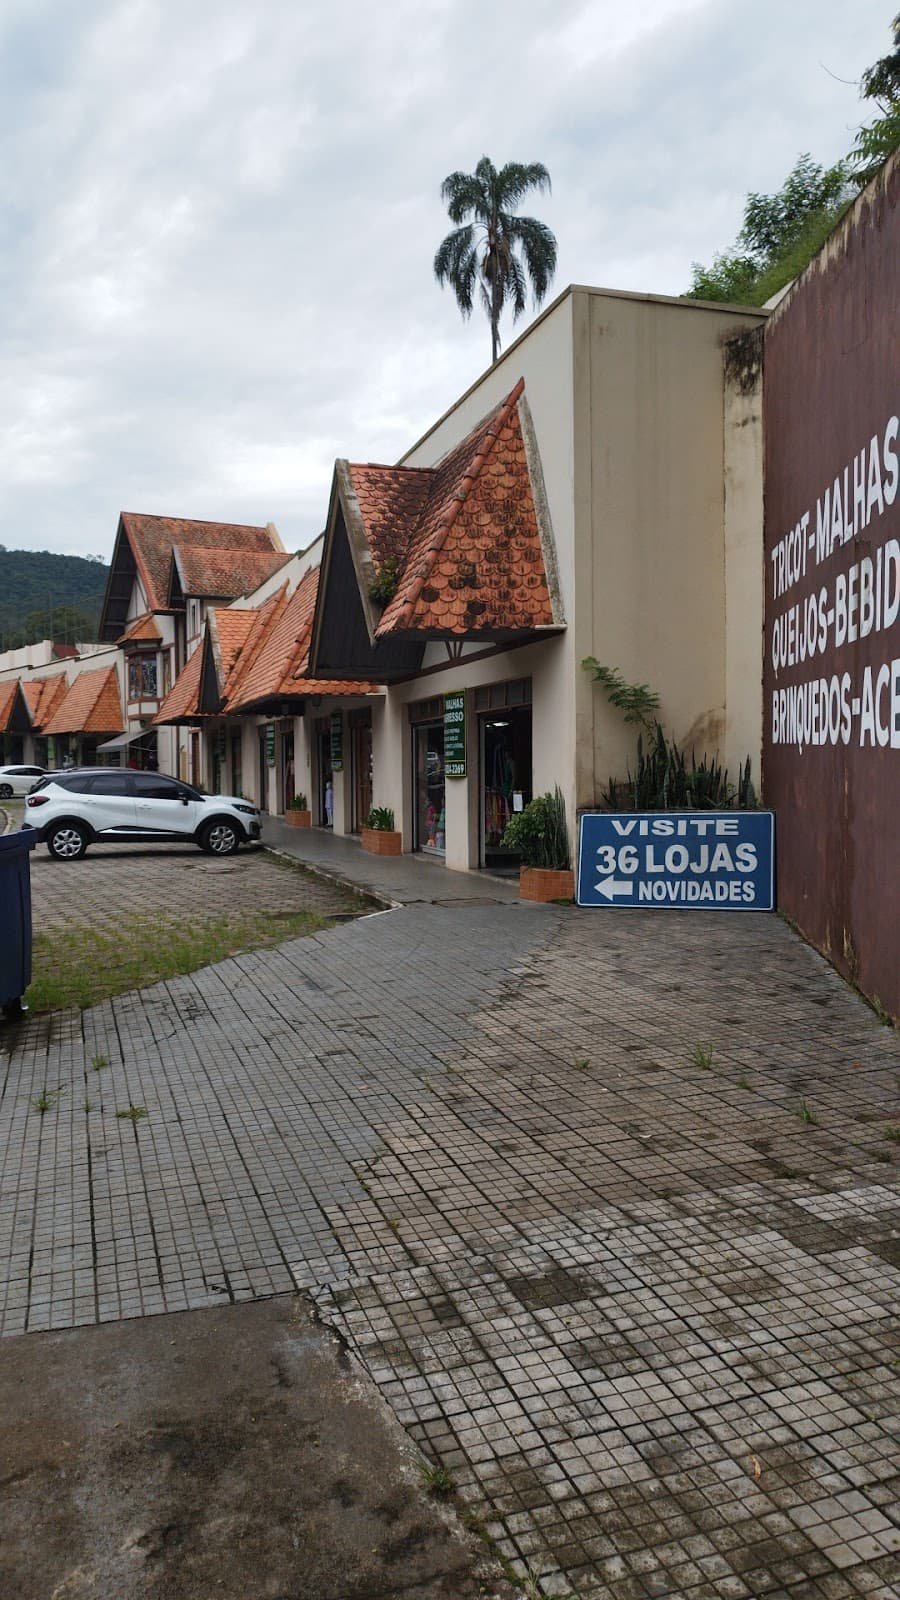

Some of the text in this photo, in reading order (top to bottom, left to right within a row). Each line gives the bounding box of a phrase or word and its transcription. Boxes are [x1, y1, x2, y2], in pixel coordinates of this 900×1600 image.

[611, 819, 740, 836] VISITE
[595, 843, 758, 874] 36 LOJAS
[638, 880, 756, 902] NOVIDADES
